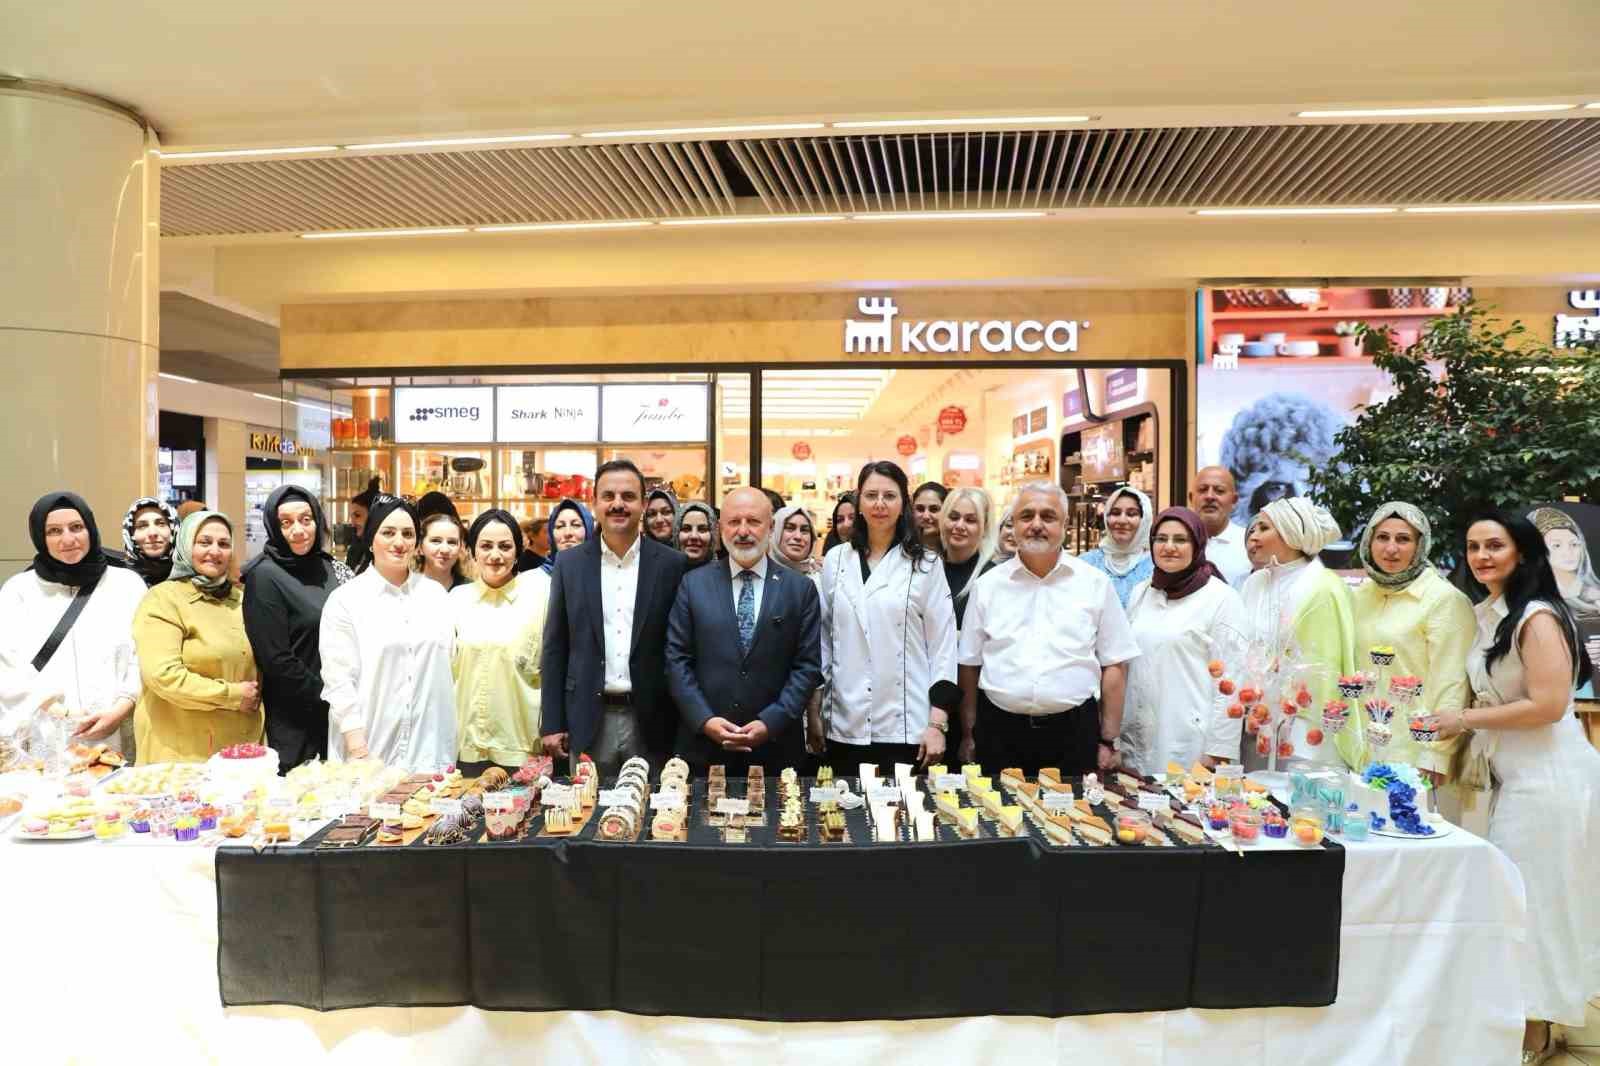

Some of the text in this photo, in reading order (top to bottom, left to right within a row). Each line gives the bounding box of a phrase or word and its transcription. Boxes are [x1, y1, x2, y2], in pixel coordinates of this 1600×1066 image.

[901, 319, 1078, 353] karaca
[433, 405, 480, 421] smeg
[511, 408, 548, 420] Shark
